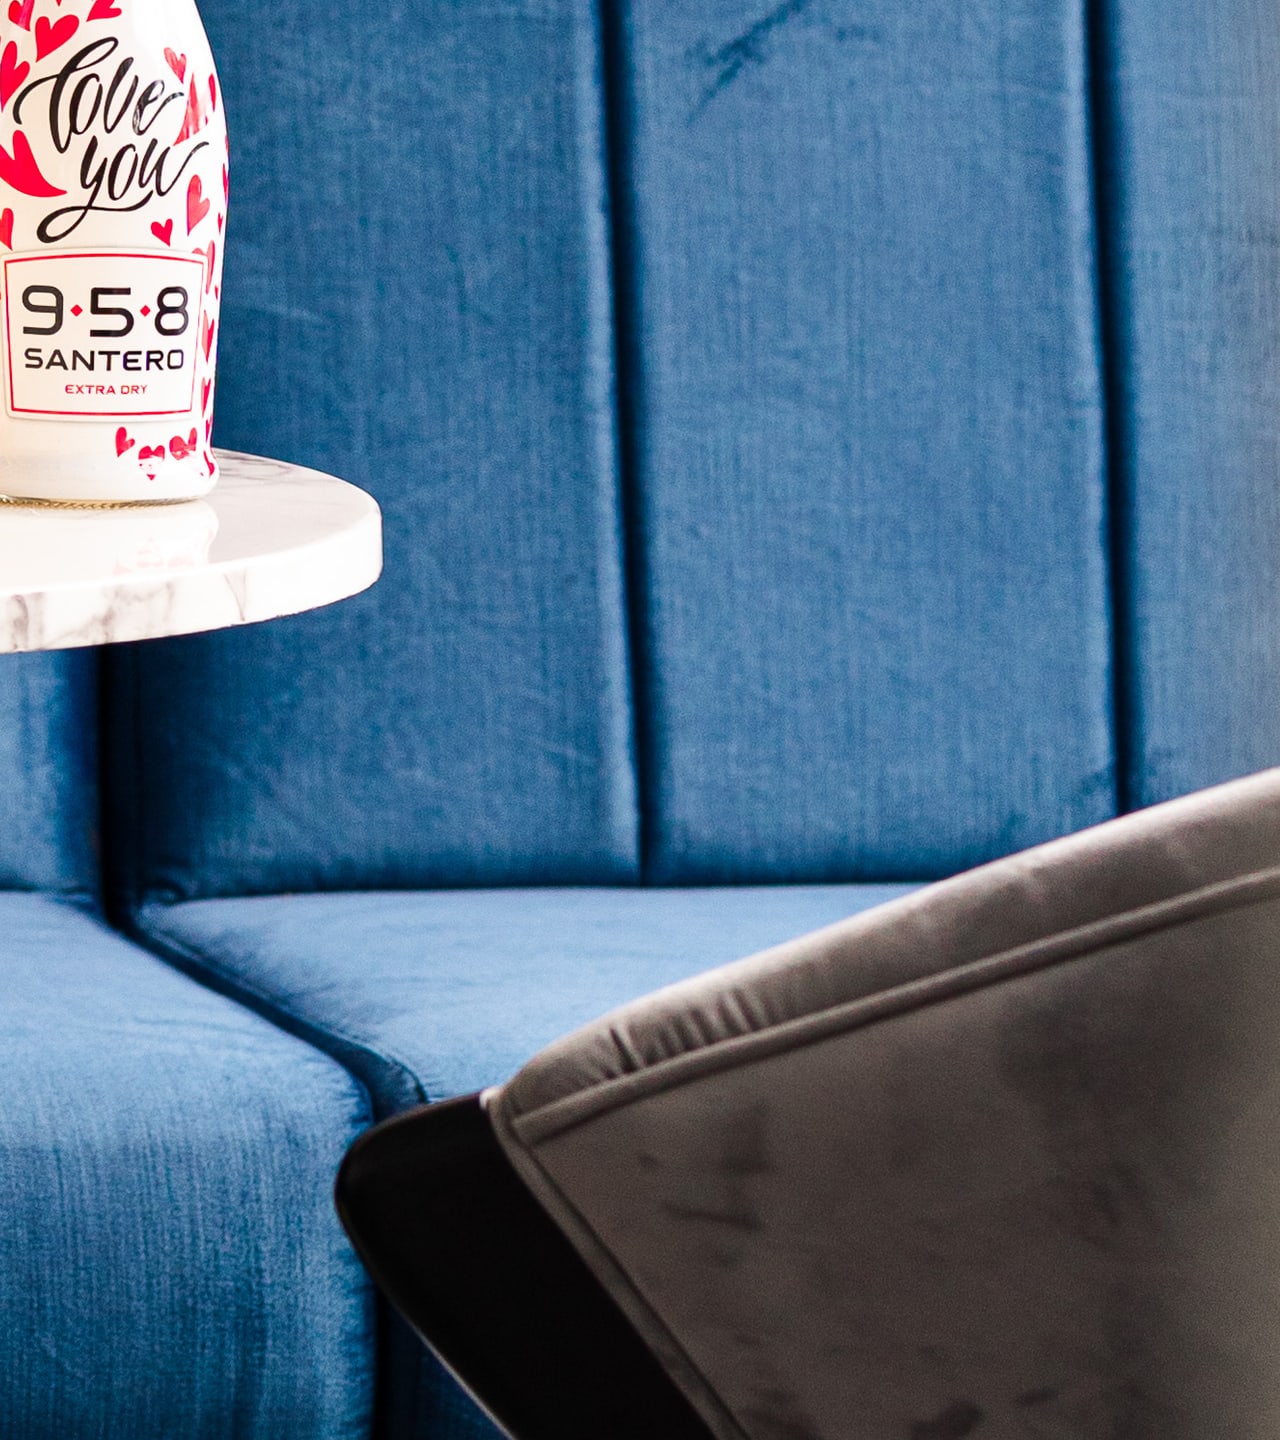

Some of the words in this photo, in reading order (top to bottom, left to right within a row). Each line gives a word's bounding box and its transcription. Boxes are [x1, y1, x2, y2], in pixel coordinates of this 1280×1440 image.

[12, 36, 184, 154] love
[36, 135, 209, 244] you
[24, 347, 184, 371] SANTERO
[65, 384, 116, 395] EXTRA
[120, 384, 148, 395] DRY
